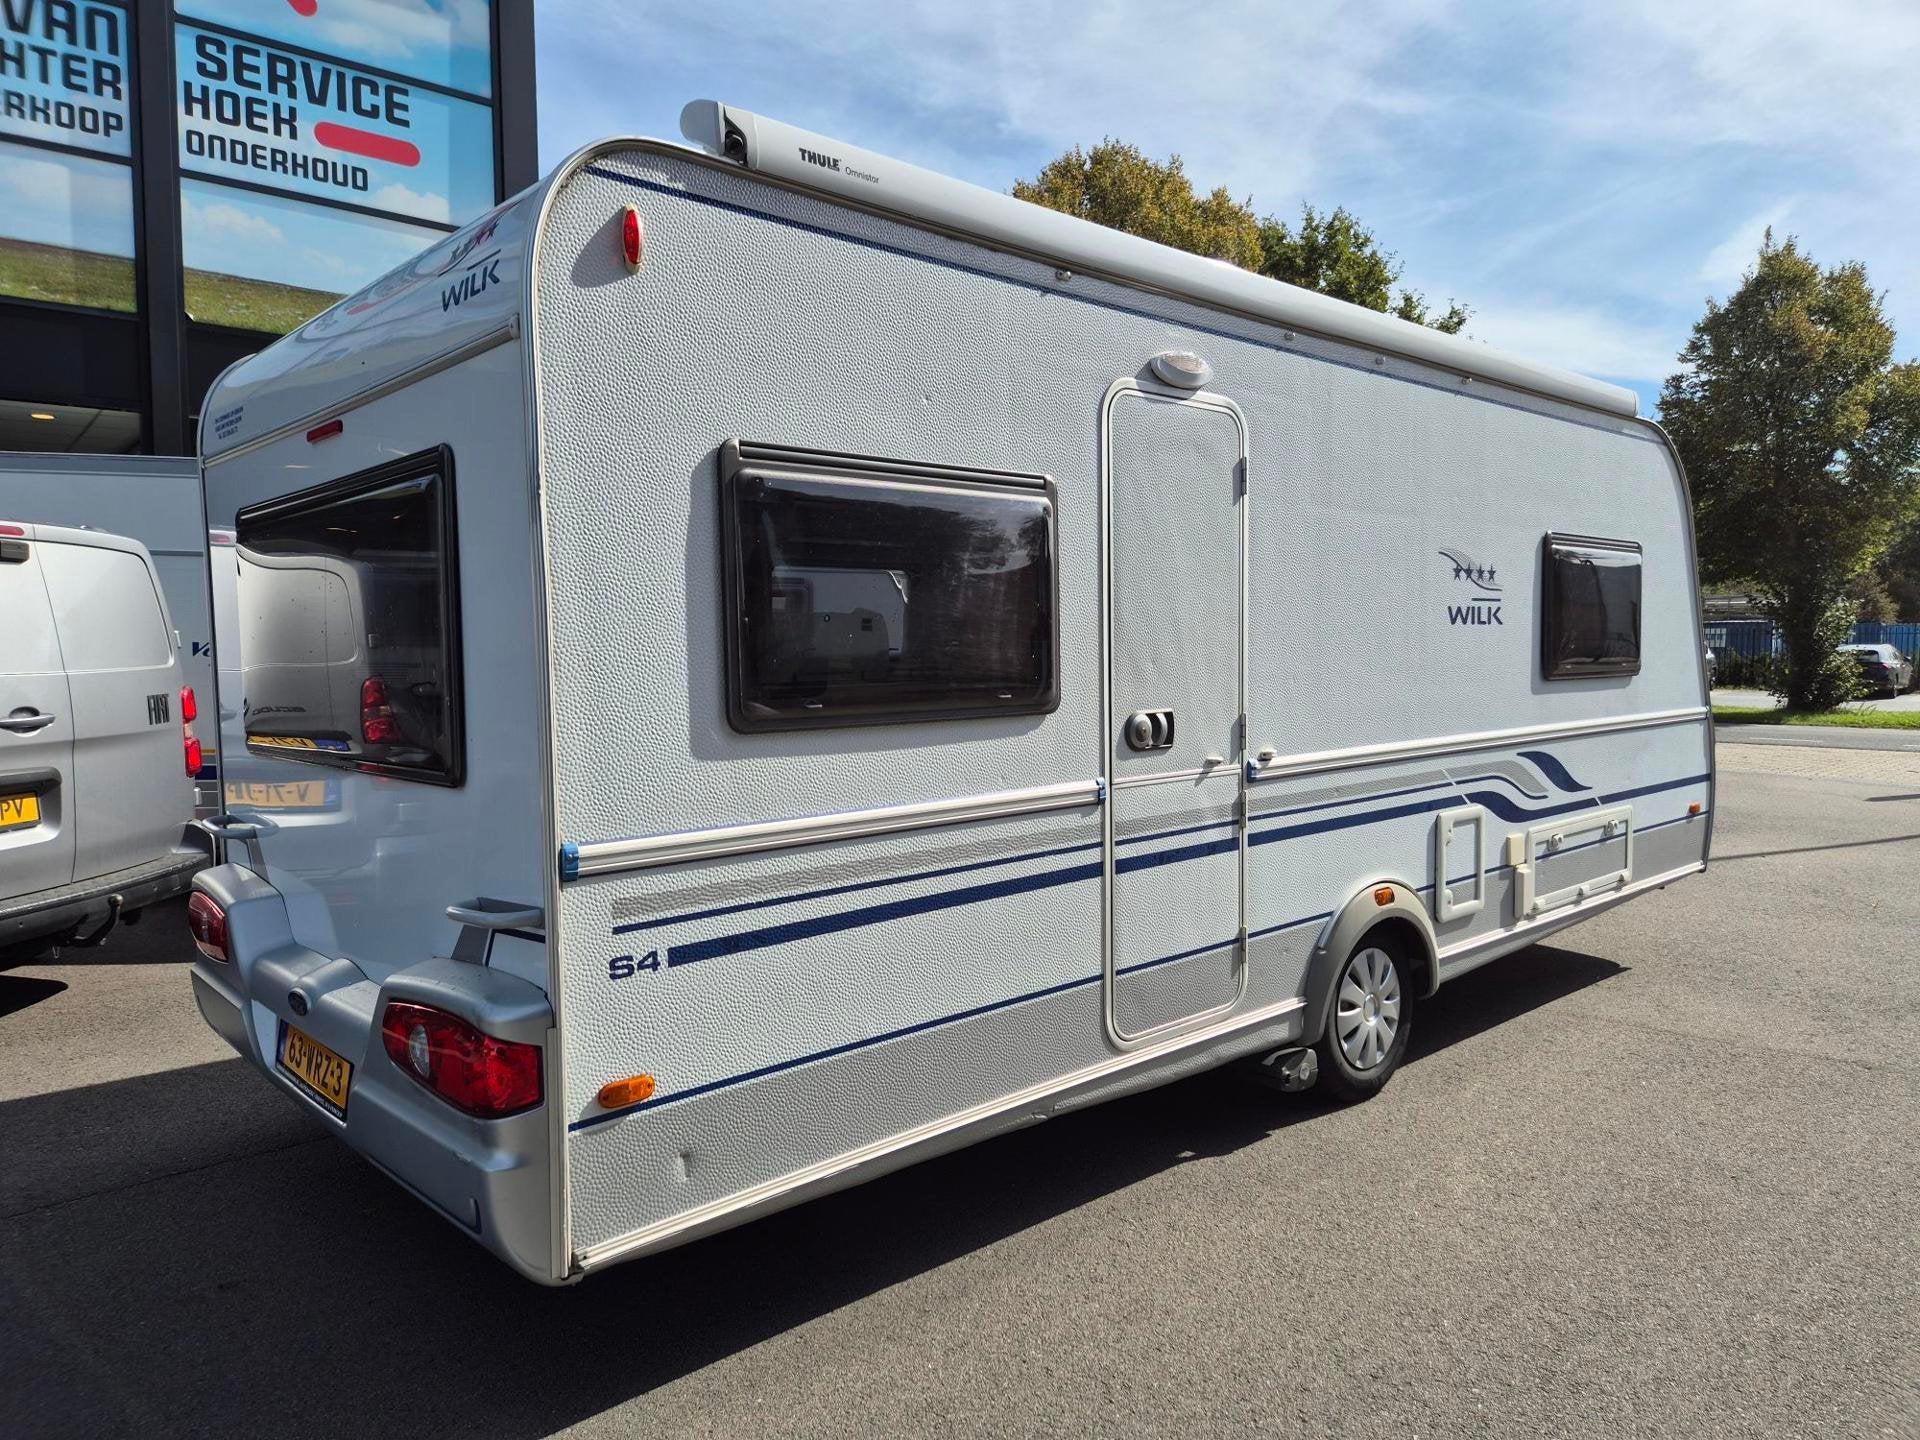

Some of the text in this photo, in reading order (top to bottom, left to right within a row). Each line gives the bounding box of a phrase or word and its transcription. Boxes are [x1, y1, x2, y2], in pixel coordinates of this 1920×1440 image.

[2, 0, 119, 57] VAN
[195, 34, 411, 128] SERVICE
[183, 80, 298, 141] HOEK
[185, 129, 369, 191] ONDERHOUD
[798, 147, 879, 184] THULE Omnistor
[442, 258, 501, 312] WILK
[1447, 605, 1503, 625] WILK
[609, 950, 661, 980] S4
[288, 1032, 343, 1097] 63-WRZ-3
